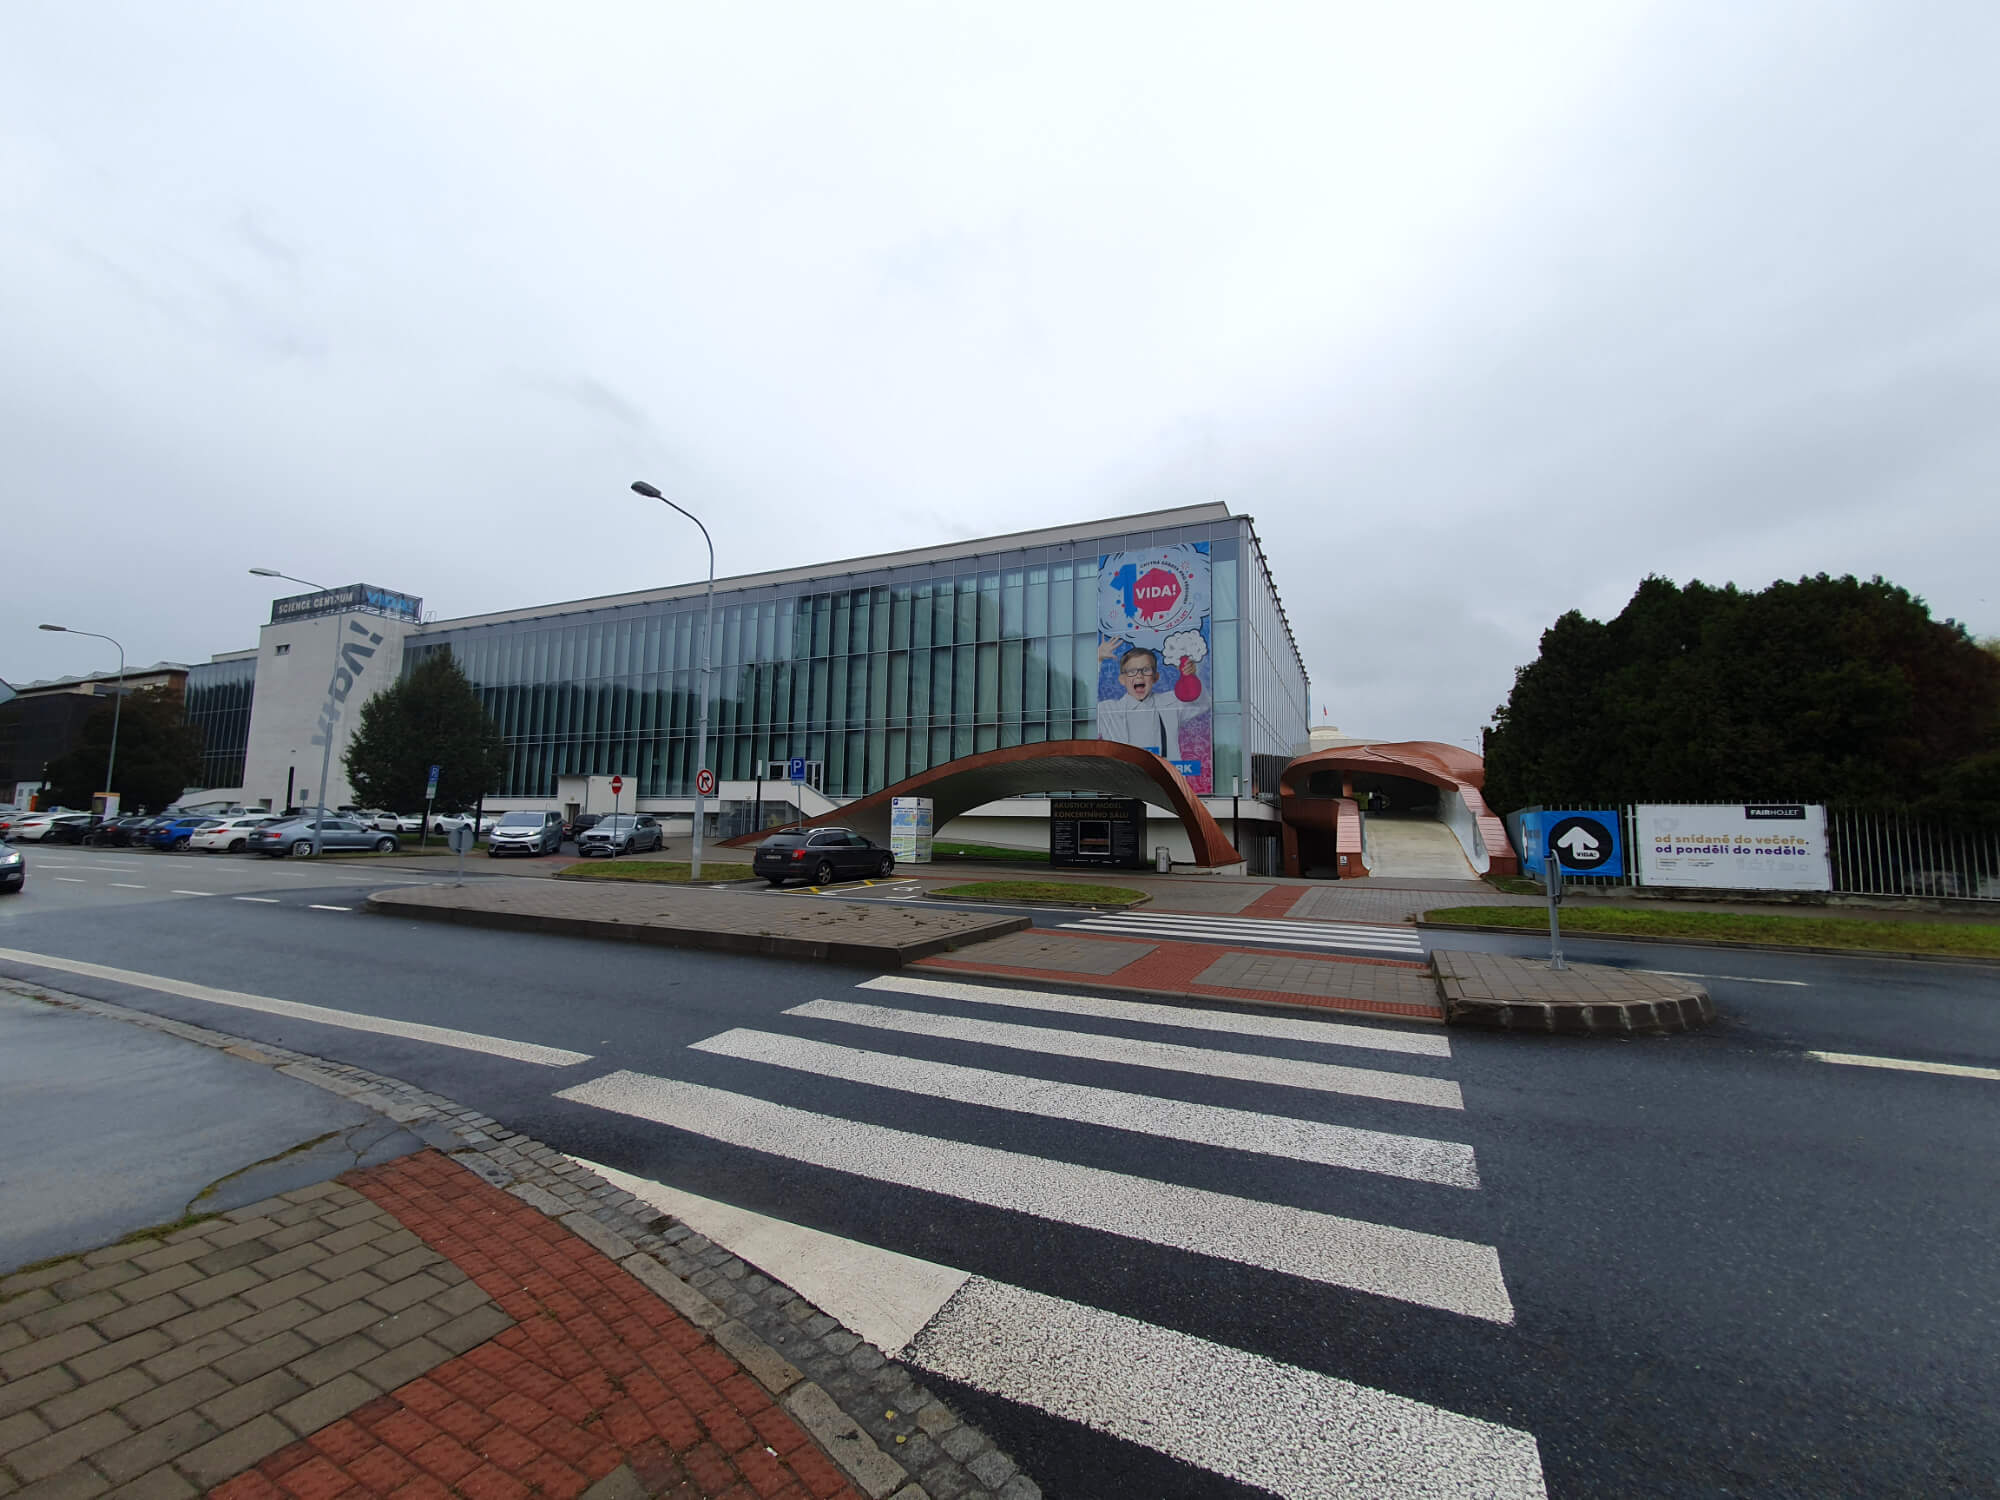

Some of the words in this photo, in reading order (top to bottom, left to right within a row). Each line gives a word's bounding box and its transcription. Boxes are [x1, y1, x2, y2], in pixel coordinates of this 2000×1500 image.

[1136, 584, 1177, 599] VIDA!
[279, 600, 311, 614] SCIENCE
[793, 760, 802, 773] P
[1655, 834, 1671, 844] od
[1675, 834, 1730, 844] snídaně
[1734, 835, 1752, 844] do
[1655, 845, 1672, 853] od
[1676, 845, 1729, 855] pondělí
[1733, 846, 1751, 854] do
